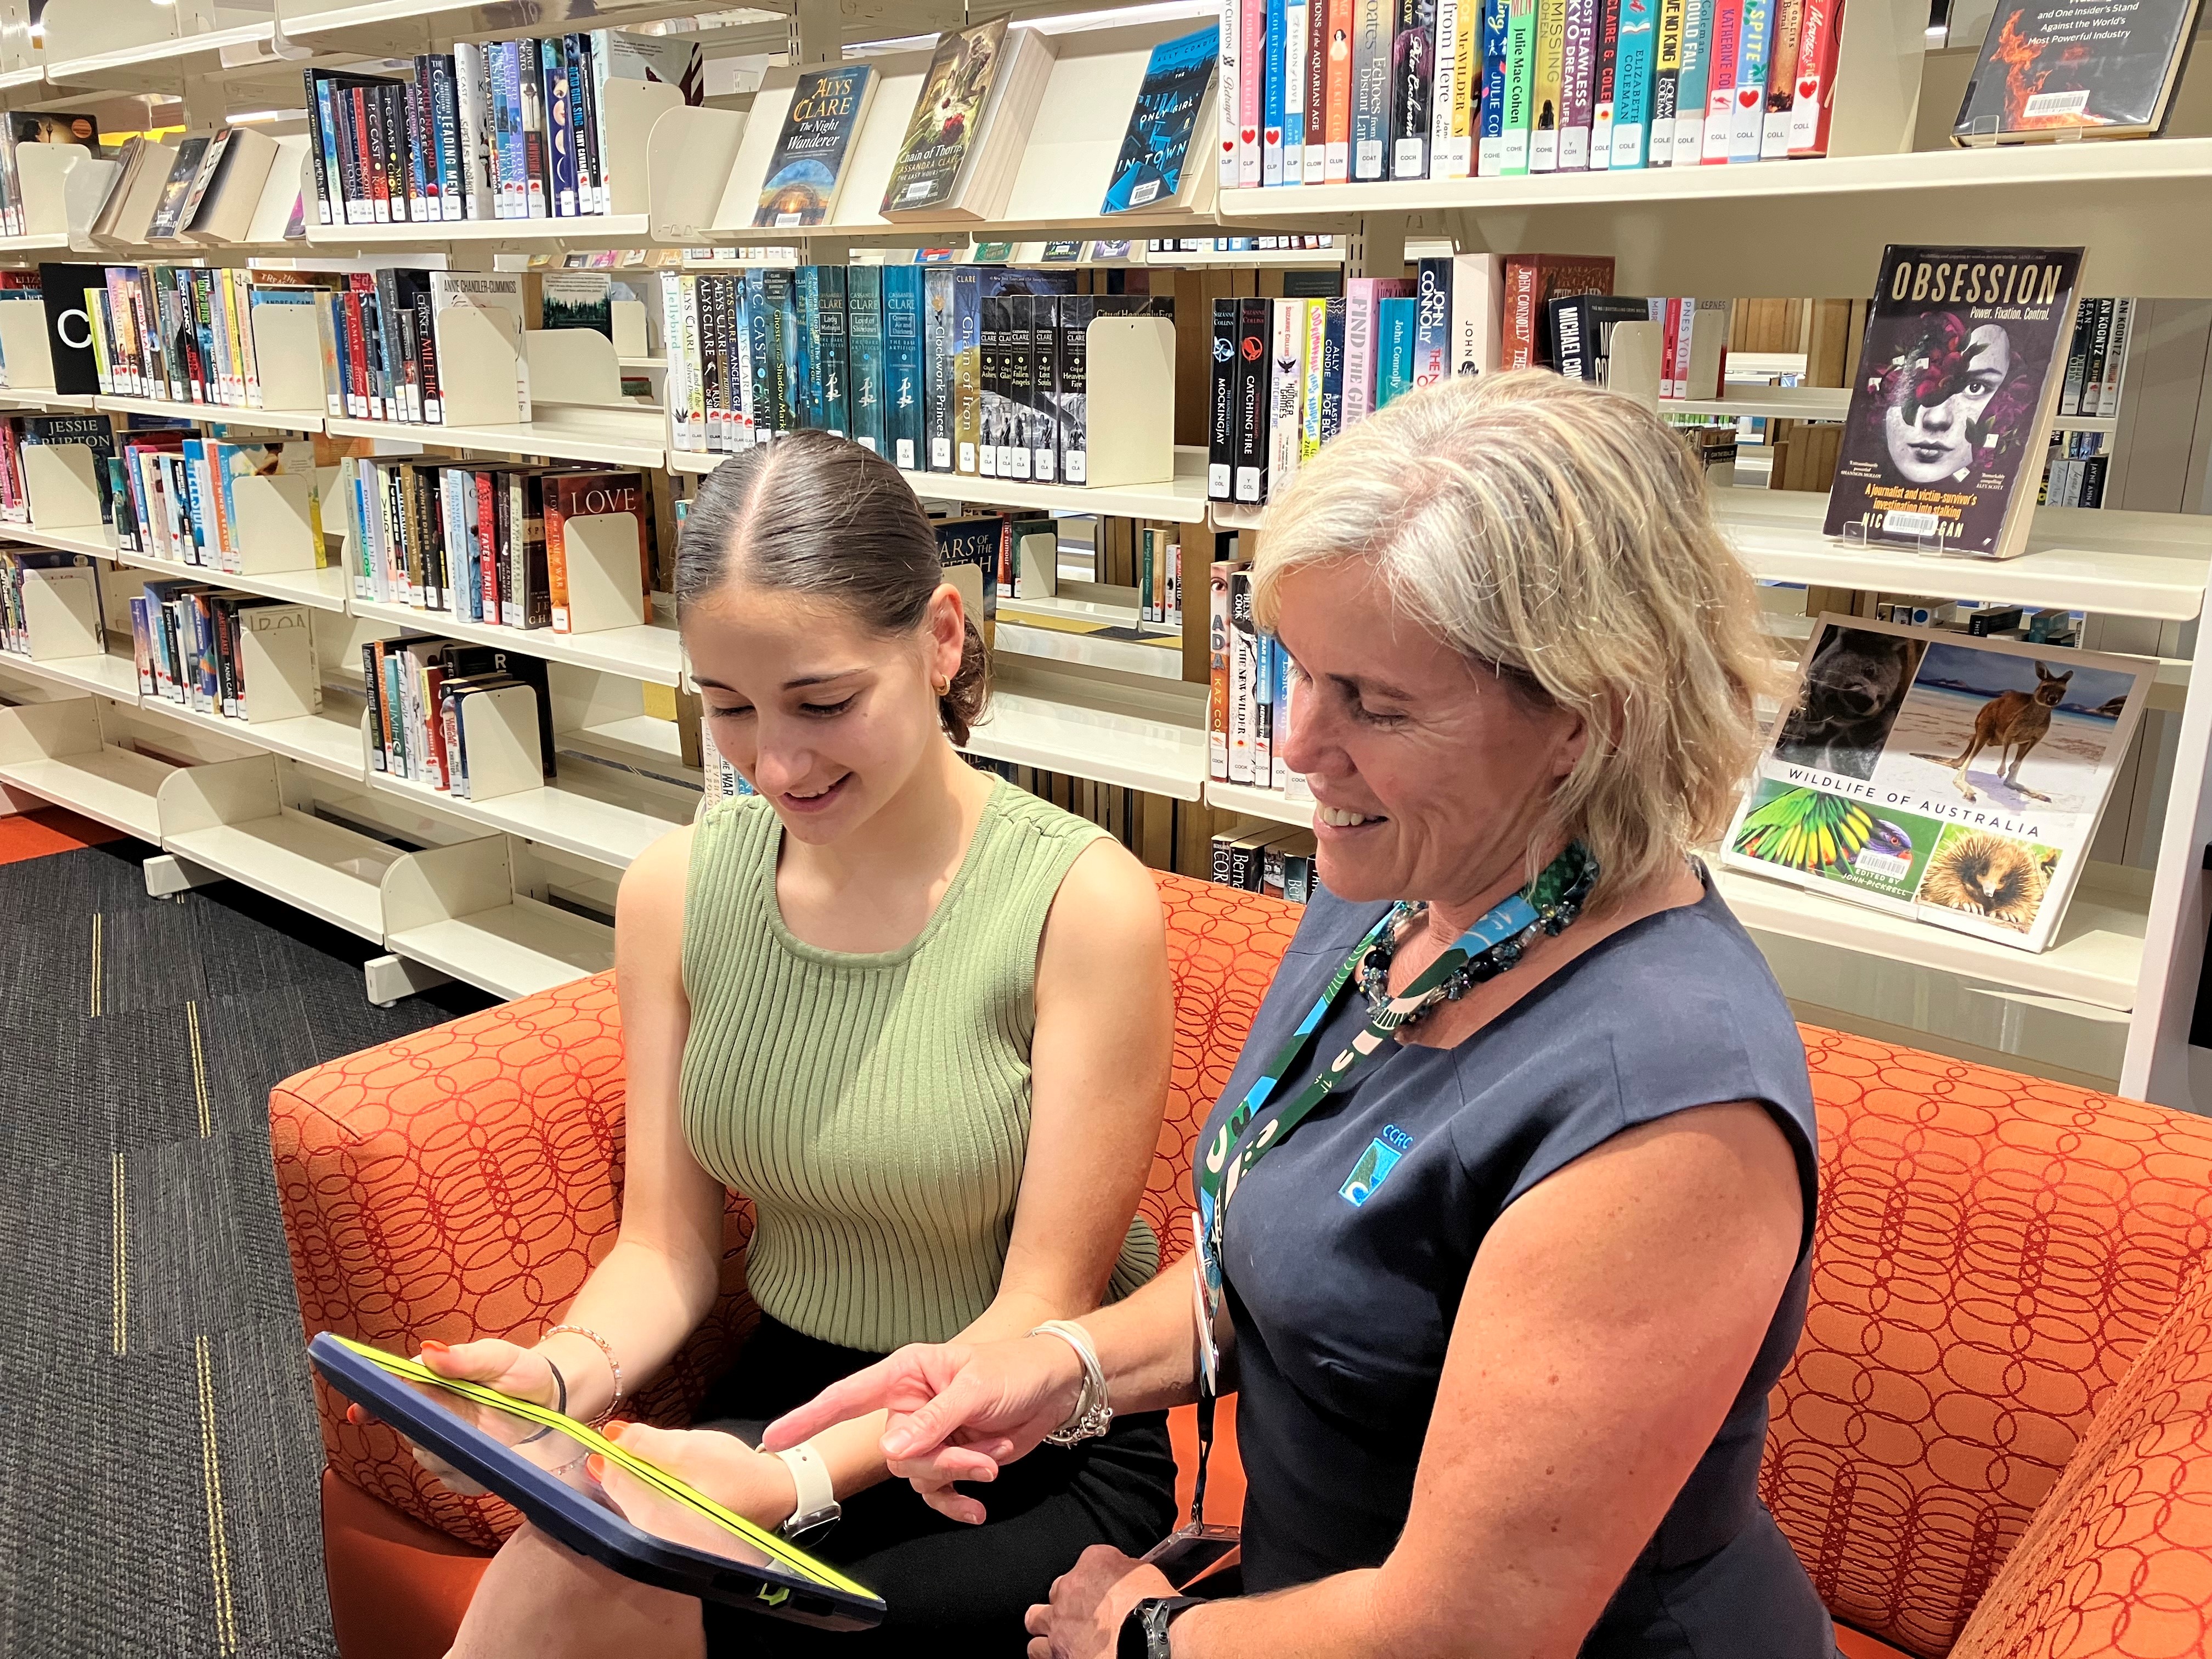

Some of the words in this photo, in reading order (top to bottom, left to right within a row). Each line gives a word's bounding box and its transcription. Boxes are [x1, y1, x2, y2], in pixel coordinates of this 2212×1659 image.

[1442, 3, 1458, 48] from
[1665, 16, 1679, 31] NO
[2038, 10, 2054, 19] and
[2056, 8, 2073, 17] One
[2075, 5, 2111, 15] Insider's
[2112, 2, 2139, 12] Stand
[2041, 22, 2073, 32] Against
[2075, 19, 2090, 27] the
[2092, 17, 2126, 26] World's
[1458, 31, 1468, 49] Mr
[1514, 27, 1526, 55] Julie
[1547, 2, 1563, 82] MISSING
[1720, 9, 1735, 69] KATHERINE
[1746, 10, 1765, 61] SPITE
[1789, 10, 1798, 48] COLLINS
[2028, 37, 2050, 46] Most
[2052, 32, 2092, 43] Powerful
[2094, 30, 2131, 40] Industry
[1158, 52, 1178, 62] ALLY
[1513, 58, 1524, 82] Mae
[1563, 46, 1576, 99] DREAM
[1576, 28, 1590, 107] FLAWLESS
[1682, 43, 1697, 74] FALL
[812, 78, 852, 99] ALYS
[1311, 50, 1321, 108] AQUARIAN
[1359, 69, 1372, 111] Distant
[1371, 57, 1386, 114] Echoes
[1439, 56, 1455, 103] Here
[1455, 52, 1468, 111] WILDER
[1489, 72, 1502, 110] JULIE
[1621, 55, 1633, 120] COLEMAN
[1631, 50, 1644, 123] ELIZABETH
[486, 87, 495, 132] CASTILLO
[793, 97, 853, 122] CLARE
[1140, 110, 1167, 123] ONLY
[1172, 97, 1193, 115] GIRL
[1223, 75, 1235, 126] Betrayed
[1510, 84, 1522, 123] Cohen
[370, 127, 380, 159] CAST
[387, 120, 396, 150] CAST
[420, 117, 428, 155] CASEY
[442, 116, 456, 164] LEADING
[576, 130, 585, 147] TONY
[787, 134, 839, 150] Wanderer
[799, 122, 811, 132] The
[812, 119, 839, 134] Night
[427, 141, 436, 167] KIND
[897, 160, 934, 174] CASSANDRA
[900, 150, 922, 163] Chain
[924, 146, 935, 159] of
[935, 144, 963, 156] Thorns
[1117, 157, 1136, 173] IN
[1144, 140, 1187, 165] TOWN
[446, 170, 459, 196] MEN
[444, 280, 460, 293] ANNIE
[460, 280, 516, 294] CHANDLER-CUMMINGS
[701, 279, 712, 312] ALYS
[726, 279, 734, 307] ALYS
[1519, 268, 1532, 292] JOHN
[1892, 262, 2062, 304] OBSESSION
[182, 299, 191, 335] CLANCY
[416, 295, 428, 336] CHANCE
[665, 290, 681, 349] Jellybird
[774, 309, 782, 341] Ghosts
[824, 315, 837, 324] Lady
[1419, 270, 1435, 344] CONNOLLY
[1432, 289, 1445, 326] JOHN
[1515, 294, 1530, 343] CONNOLLY
[1970, 306, 1992, 319] Power.
[1995, 307, 2022, 320] Fixation.
[2024, 307, 2049, 320] Control.
[57, 309, 93, 348] C
[349, 317, 359, 351] TAMAR
[702, 313, 715, 357] CLARE
[753, 315, 766, 364] CAST
[962, 317, 973, 366] Chain
[1393, 320, 1404, 344] John
[1465, 320, 1473, 357] JOHN
[1558, 306, 1582, 358] MICHAEL
[2094, 317, 2109, 356] KOONTZ
[2112, 315, 2126, 356] KOONTZ
[421, 338, 435, 375] MILE
[935, 326, 945, 391] Clockwork
[1324, 339, 1333, 377] CONDIE
[1390, 347, 1403, 388] Connolly
[776, 363, 785, 401] Shadow
[1216, 377, 1226, 444] MOCKINGJAY
[1245, 375, 1255, 431] CATCHING
[1323, 393, 1331, 416] POE
[48, 420, 98, 436] JESSIE
[571, 488, 636, 515] LOVE
[1865, 483, 1871, 495] A
[1870, 485, 1904, 500] journalist
[1905, 488, 1918, 500] and
[1919, 488, 1977, 506] victim-survivor's
[1873, 497, 1917, 512] investigation
[1918, 501, 1932, 514] into
[1933, 504, 1962, 521] stalking
[221, 517, 230, 552] SEASON
[381, 498, 392, 570] VERIFY
[481, 532, 490, 562] FATES
[977, 535, 989, 545] OF
[977, 544, 992, 554] THE
[1211, 614, 1226, 670] ADA
[1214, 678, 1222, 705] KAZ
[1789, 768, 1877, 798] WILDLIFE
[1887, 792, 1911, 805] OF
[1919, 799, 2039, 837] AUSTRALIA
[1855, 868, 1886, 881] EDITED
[1866, 879, 1906, 896] PICKRELL
[1383, 1125, 1413, 1149] CCRC
